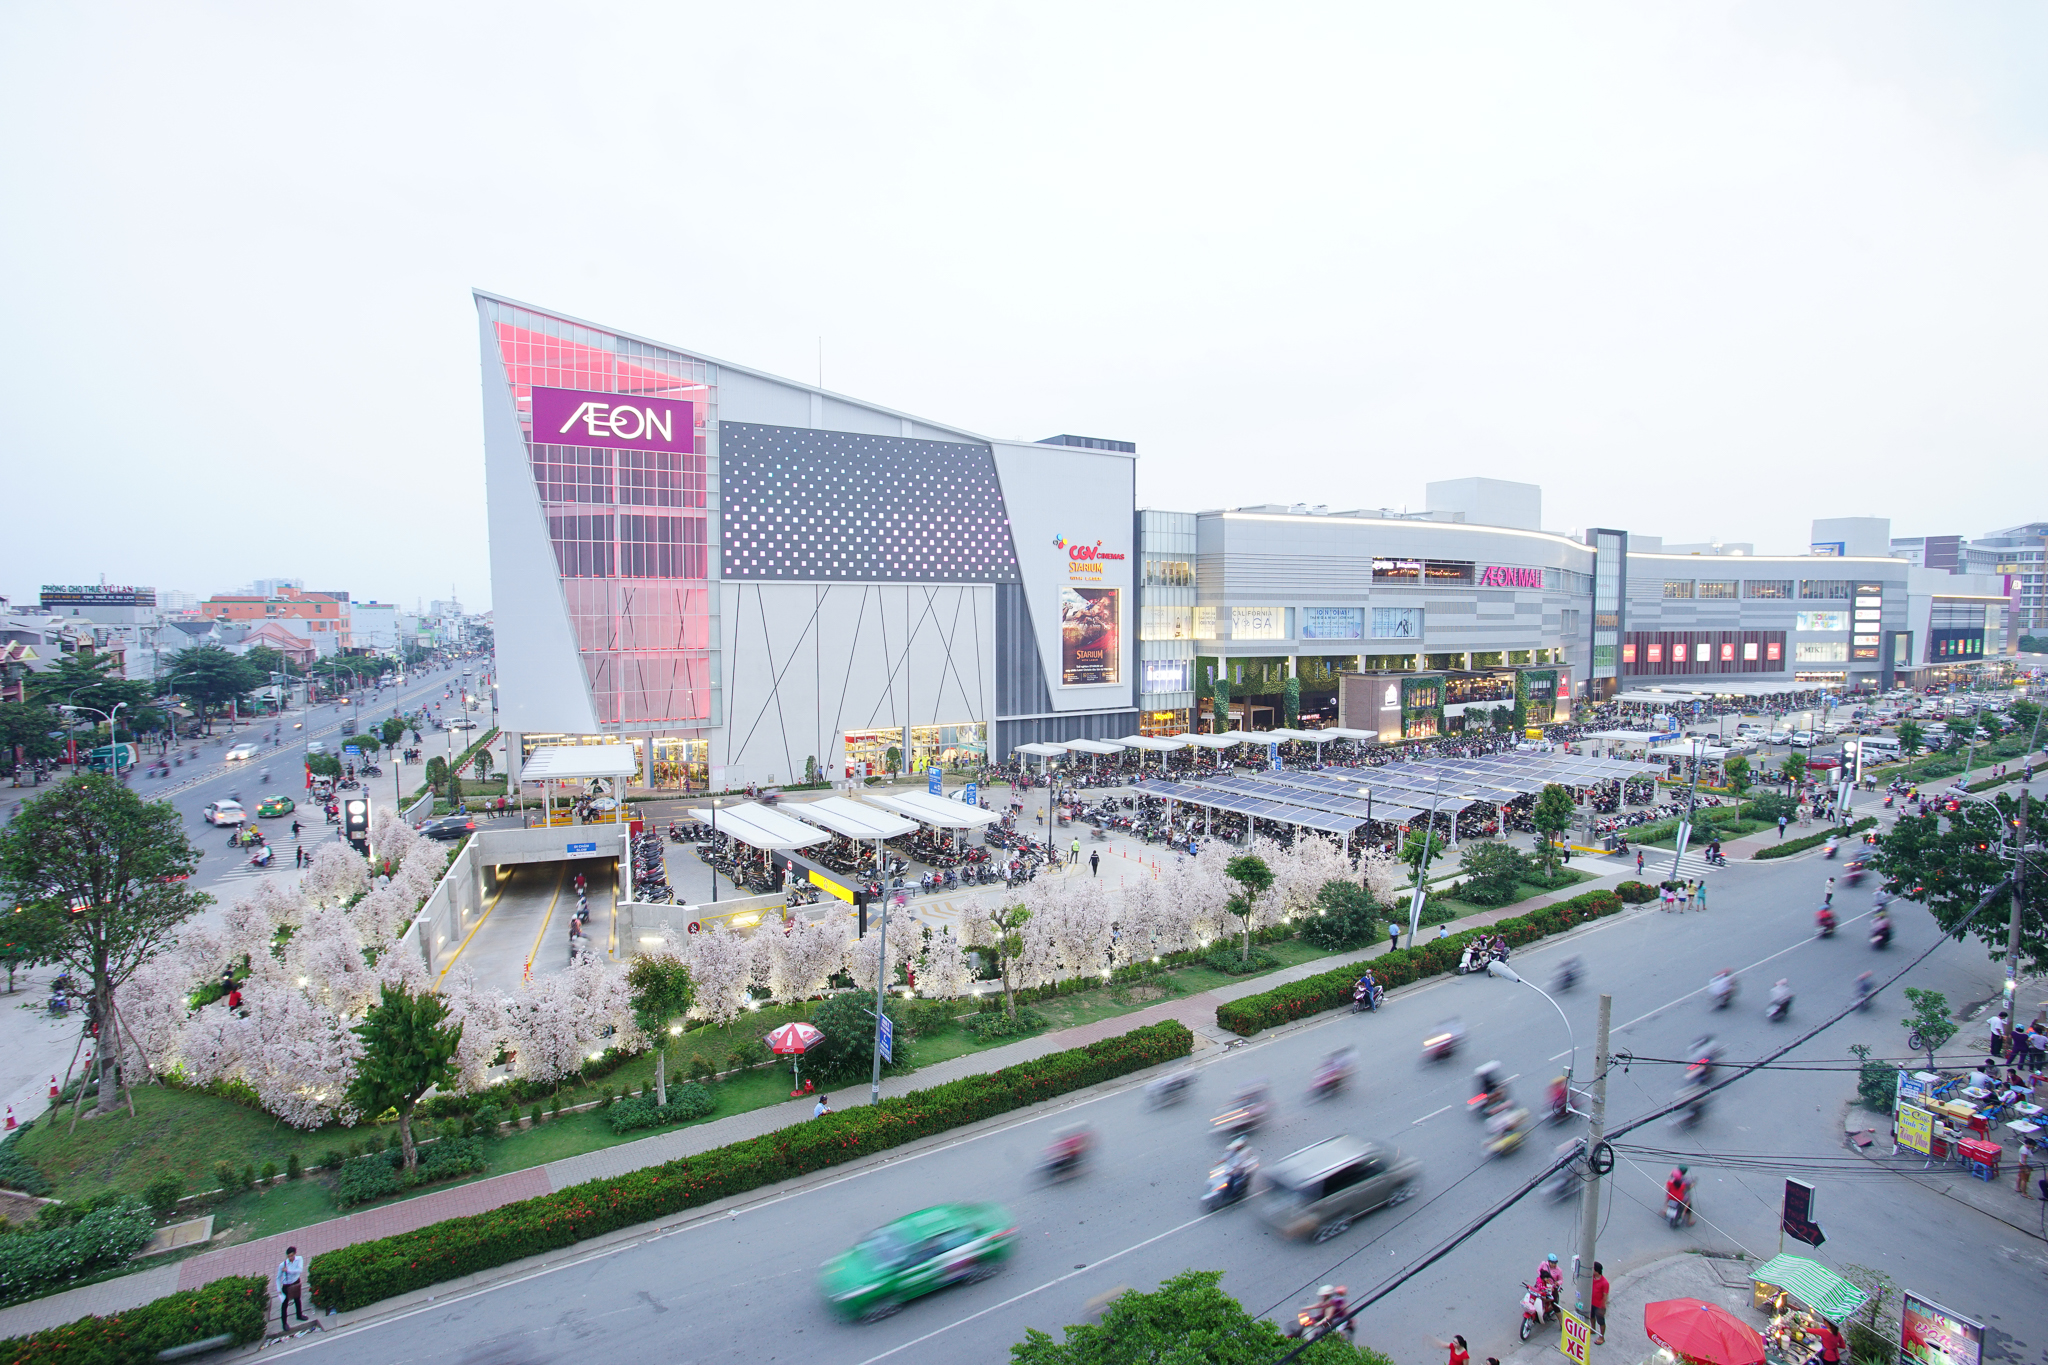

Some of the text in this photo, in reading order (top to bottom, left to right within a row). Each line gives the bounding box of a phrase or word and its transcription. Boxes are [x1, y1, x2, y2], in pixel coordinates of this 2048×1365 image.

[1069, 545, 1125, 560] CGV CINEMAS
[1069, 561, 1103, 573] STARIUM
[1518, 568, 1545, 588] MALL
[67, 585, 82, 593] CHO
[1076, 650, 1103, 659] STARIUM
[1790, 1196, 1804, 1209] CHO
[1566, 1338, 1584, 1361] XE
